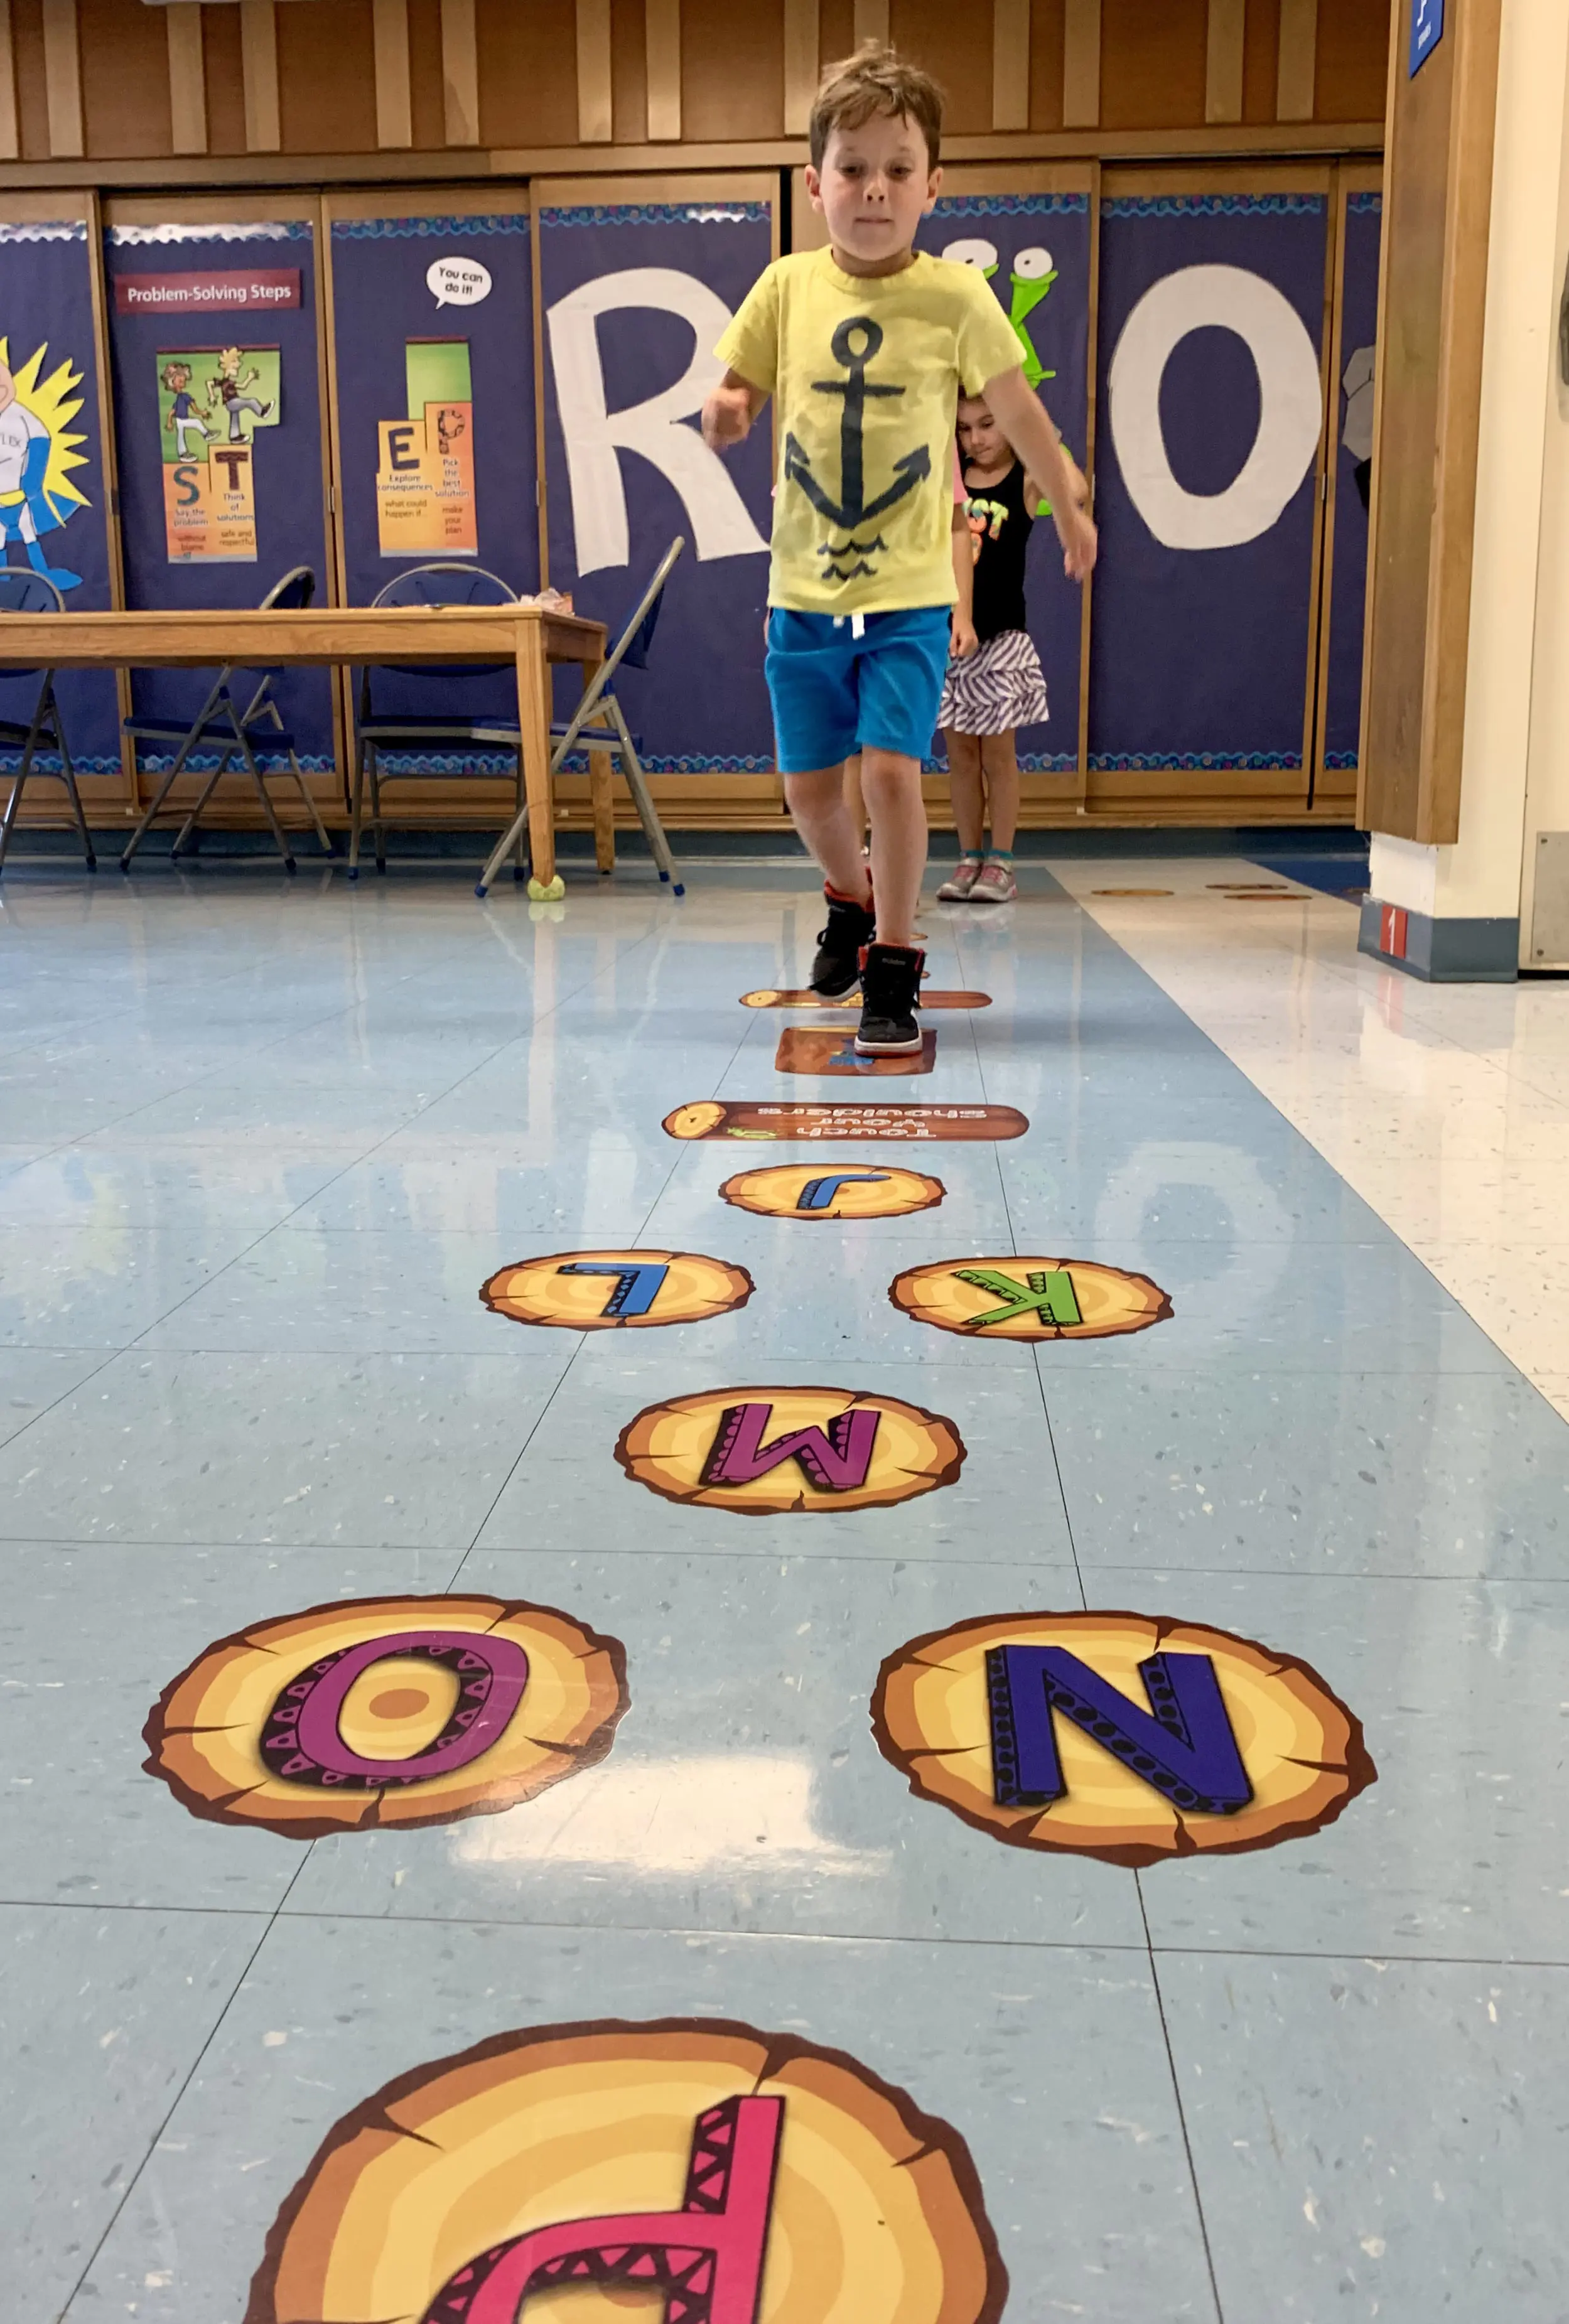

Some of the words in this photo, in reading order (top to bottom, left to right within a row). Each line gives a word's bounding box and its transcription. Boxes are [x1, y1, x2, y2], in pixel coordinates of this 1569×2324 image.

[439, 266, 460, 279] You
[462, 272, 483, 284] can
[127, 284, 247, 303] Problem-Solving
[251, 284, 292, 301] Steps
[445, 282, 459, 293] do
[462, 284, 473, 296] it!
[1109, 264, 1323, 550] O
[545, 267, 772, 576] R
[438, 409, 465, 455] P
[388, 427, 420, 471] E
[215, 451, 249, 491] T
[445, 469, 458, 477] the
[389, 474, 421, 483] Explore
[443, 479, 461, 487] best
[173, 466, 200, 507] S
[378, 483, 433, 492] consequences
[224, 492, 245, 501] Think
[435, 490, 470, 498] solution
[230, 503, 240, 512] of
[385, 500, 405, 508] what
[176, 509, 189, 518] Say
[192, 508, 206, 516] the
[217, 514, 254, 522] solutions
[385, 509, 415, 519] happen
[173, 517, 208, 527] problem
[445, 515, 461, 525] your
[445, 525, 462, 535] plan
[796, 1127, 937, 1138] Touch
[795, 1173, 893, 1210] J
[557, 1262, 670, 1318] L
[952, 1269, 1084, 1326] K
[698, 1402, 883, 1492] M
[258, 1630, 531, 1791] O
[984, 1643, 1255, 1816] N
